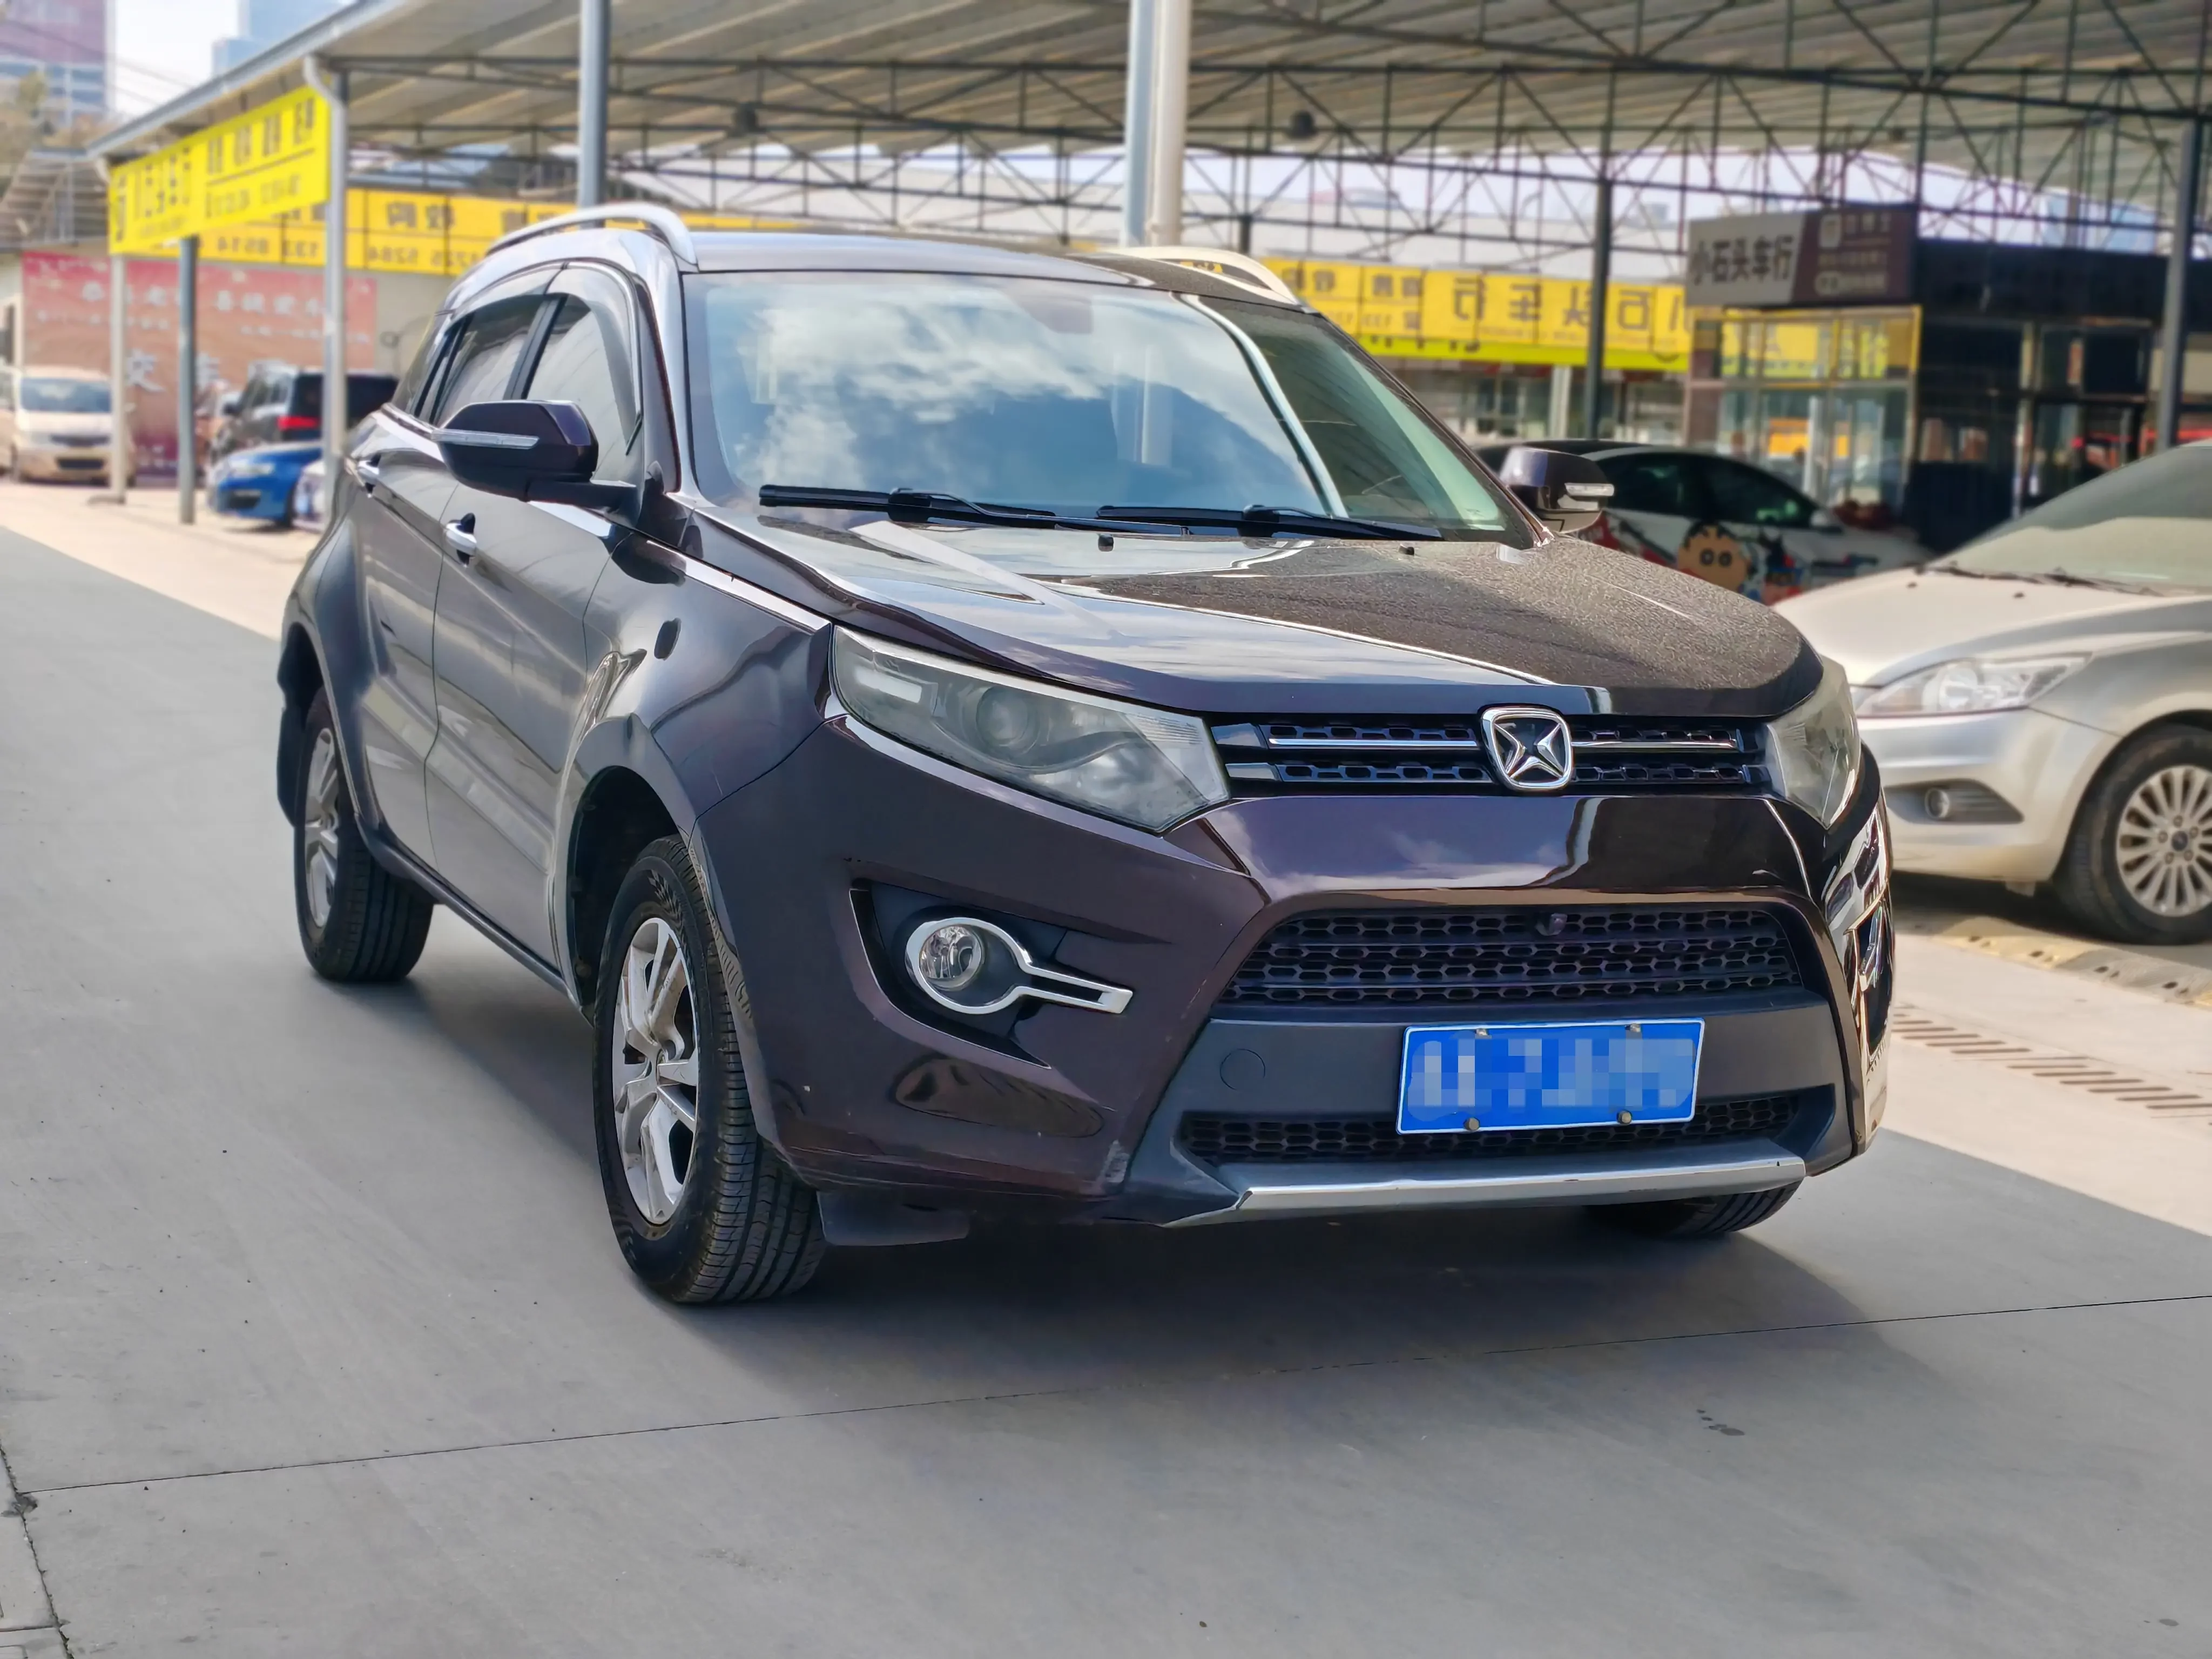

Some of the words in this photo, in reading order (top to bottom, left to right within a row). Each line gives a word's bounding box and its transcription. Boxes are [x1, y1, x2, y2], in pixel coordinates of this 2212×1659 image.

[1690, 233, 1795, 287] 小石头车行
